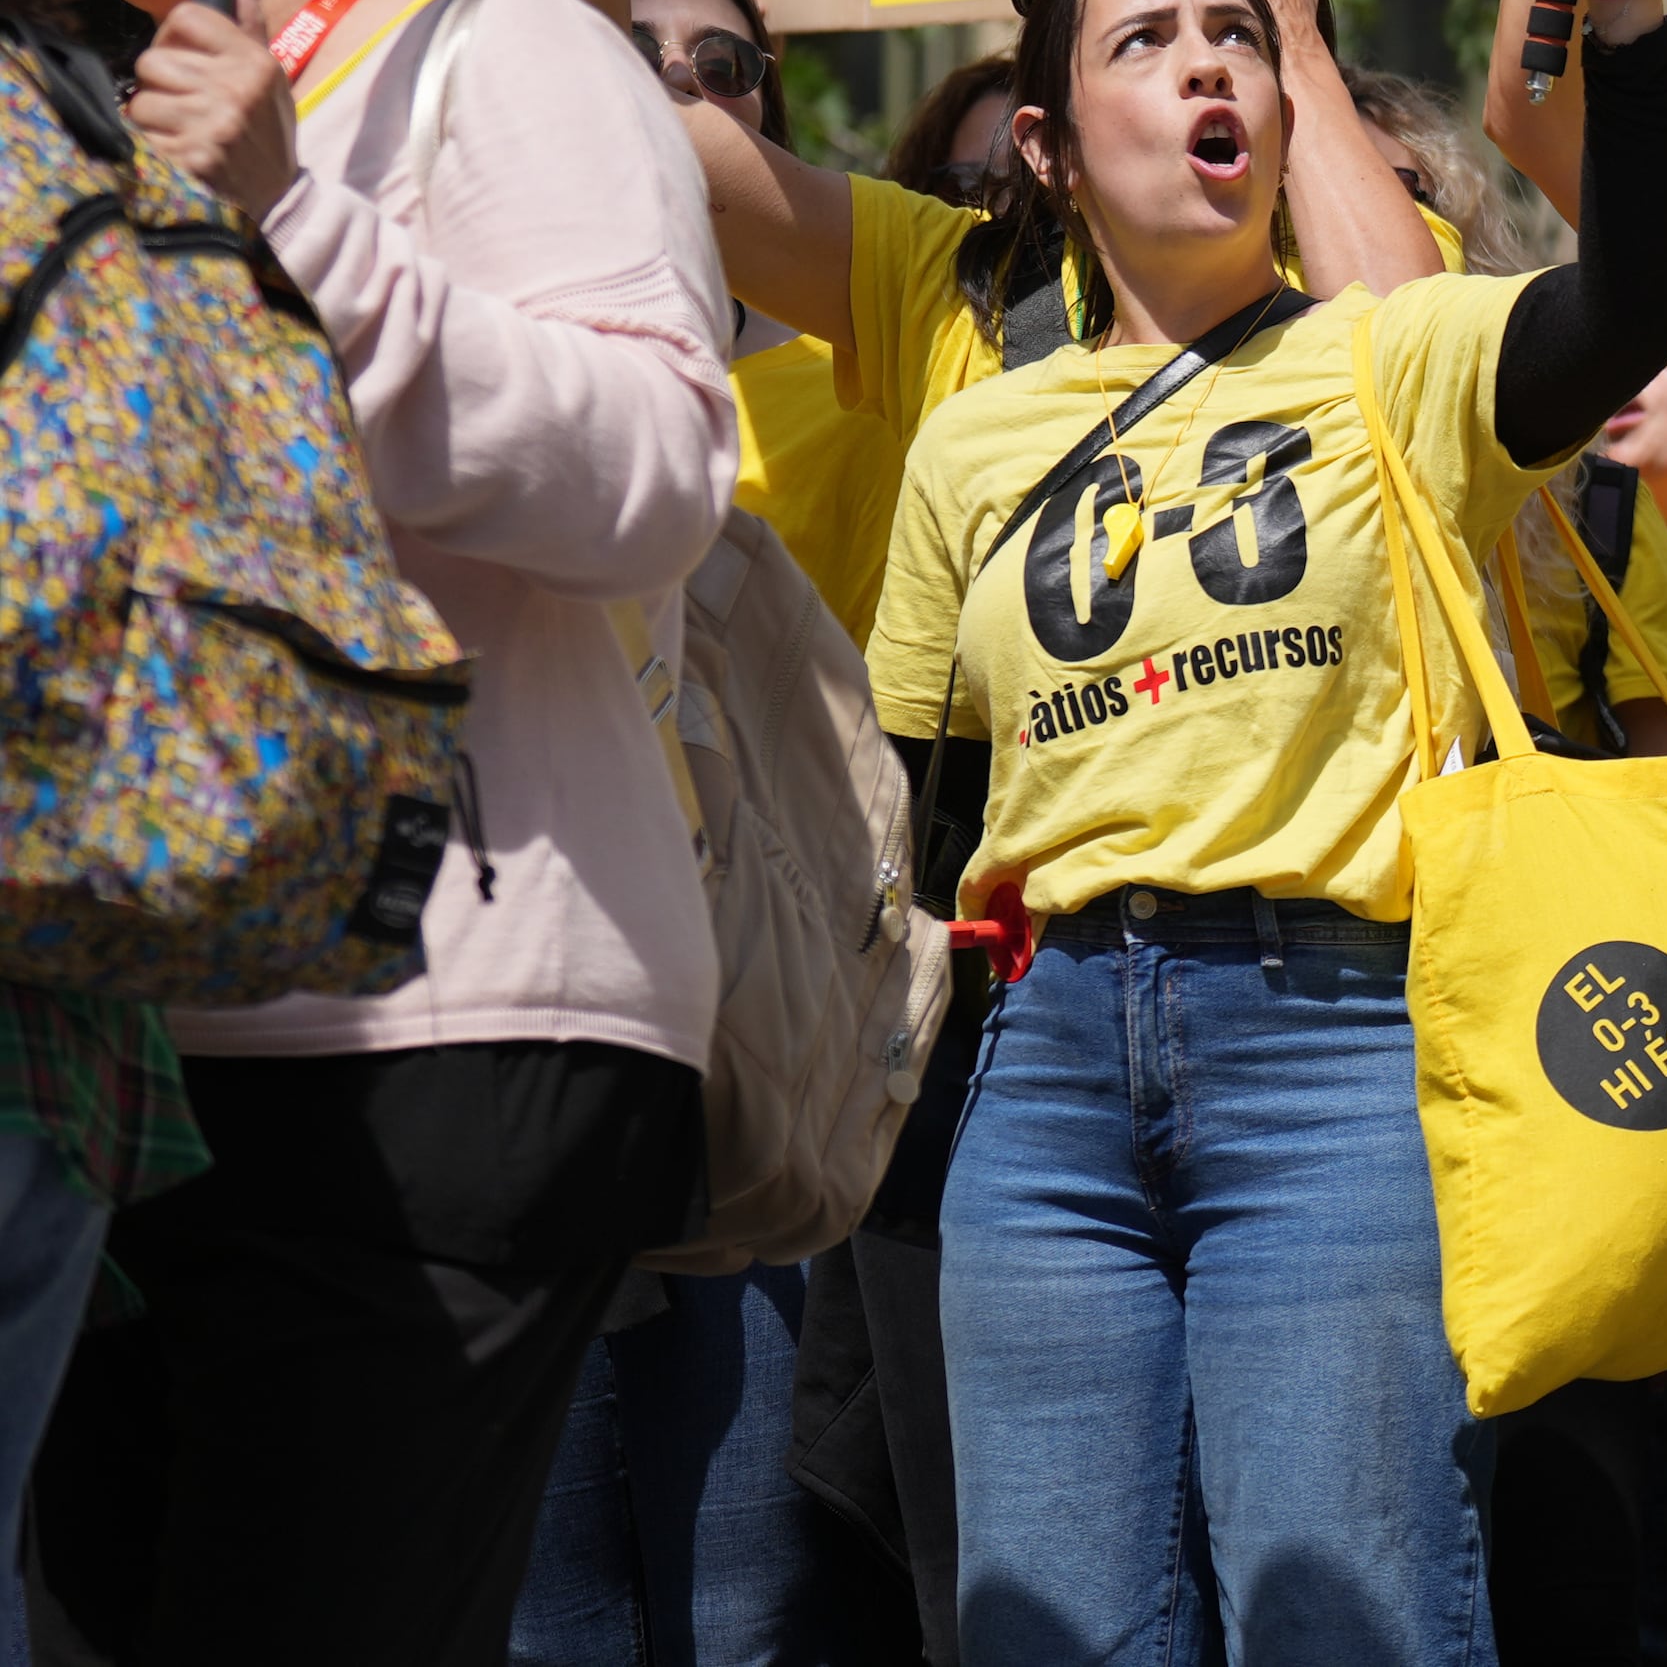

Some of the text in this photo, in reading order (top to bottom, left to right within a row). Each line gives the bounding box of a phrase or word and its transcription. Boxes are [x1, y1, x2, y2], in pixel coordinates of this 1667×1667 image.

[1023, 420, 1313, 663] 0-3
[1563, 962, 1626, 1014] EL
[1592, 990, 1660, 1053] 0-3
[1600, 1058, 1653, 1110] HI
